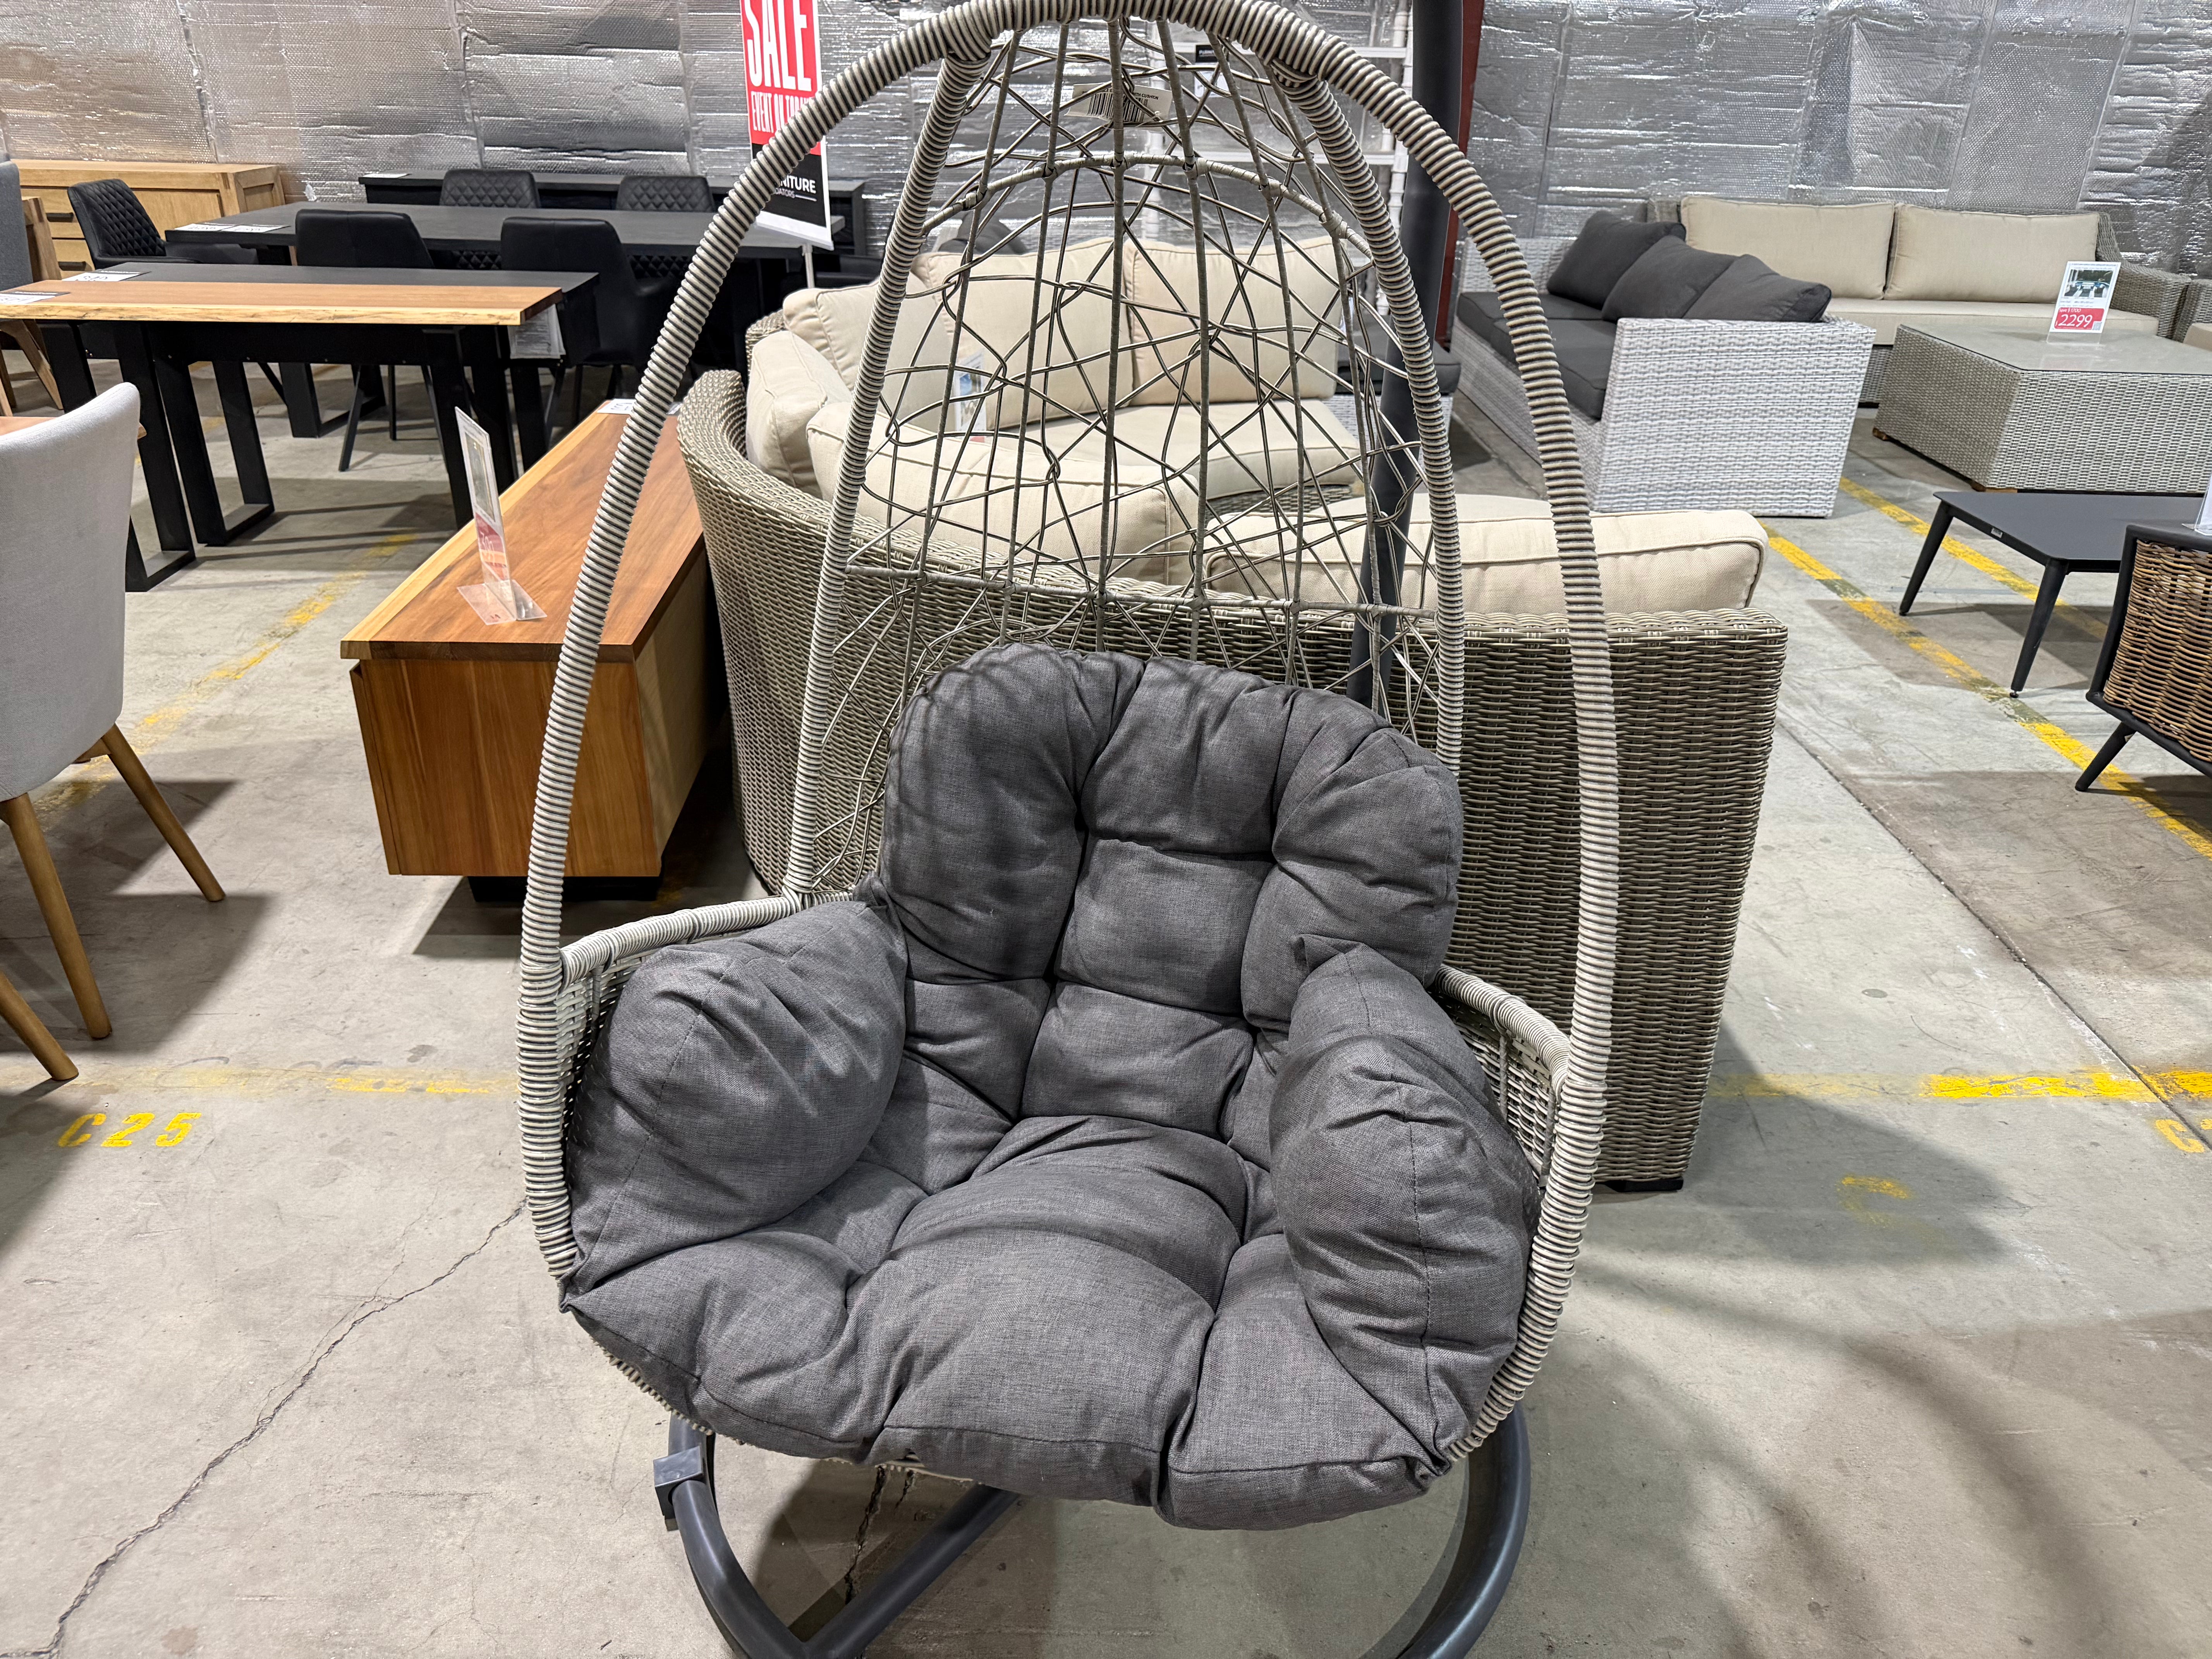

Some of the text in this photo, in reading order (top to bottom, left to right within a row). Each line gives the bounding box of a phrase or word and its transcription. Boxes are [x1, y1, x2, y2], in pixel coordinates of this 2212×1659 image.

[744, 0, 812, 92] SALE
[751, 91, 774, 133] EVENT
[58, 1112, 203, 1147] C25
